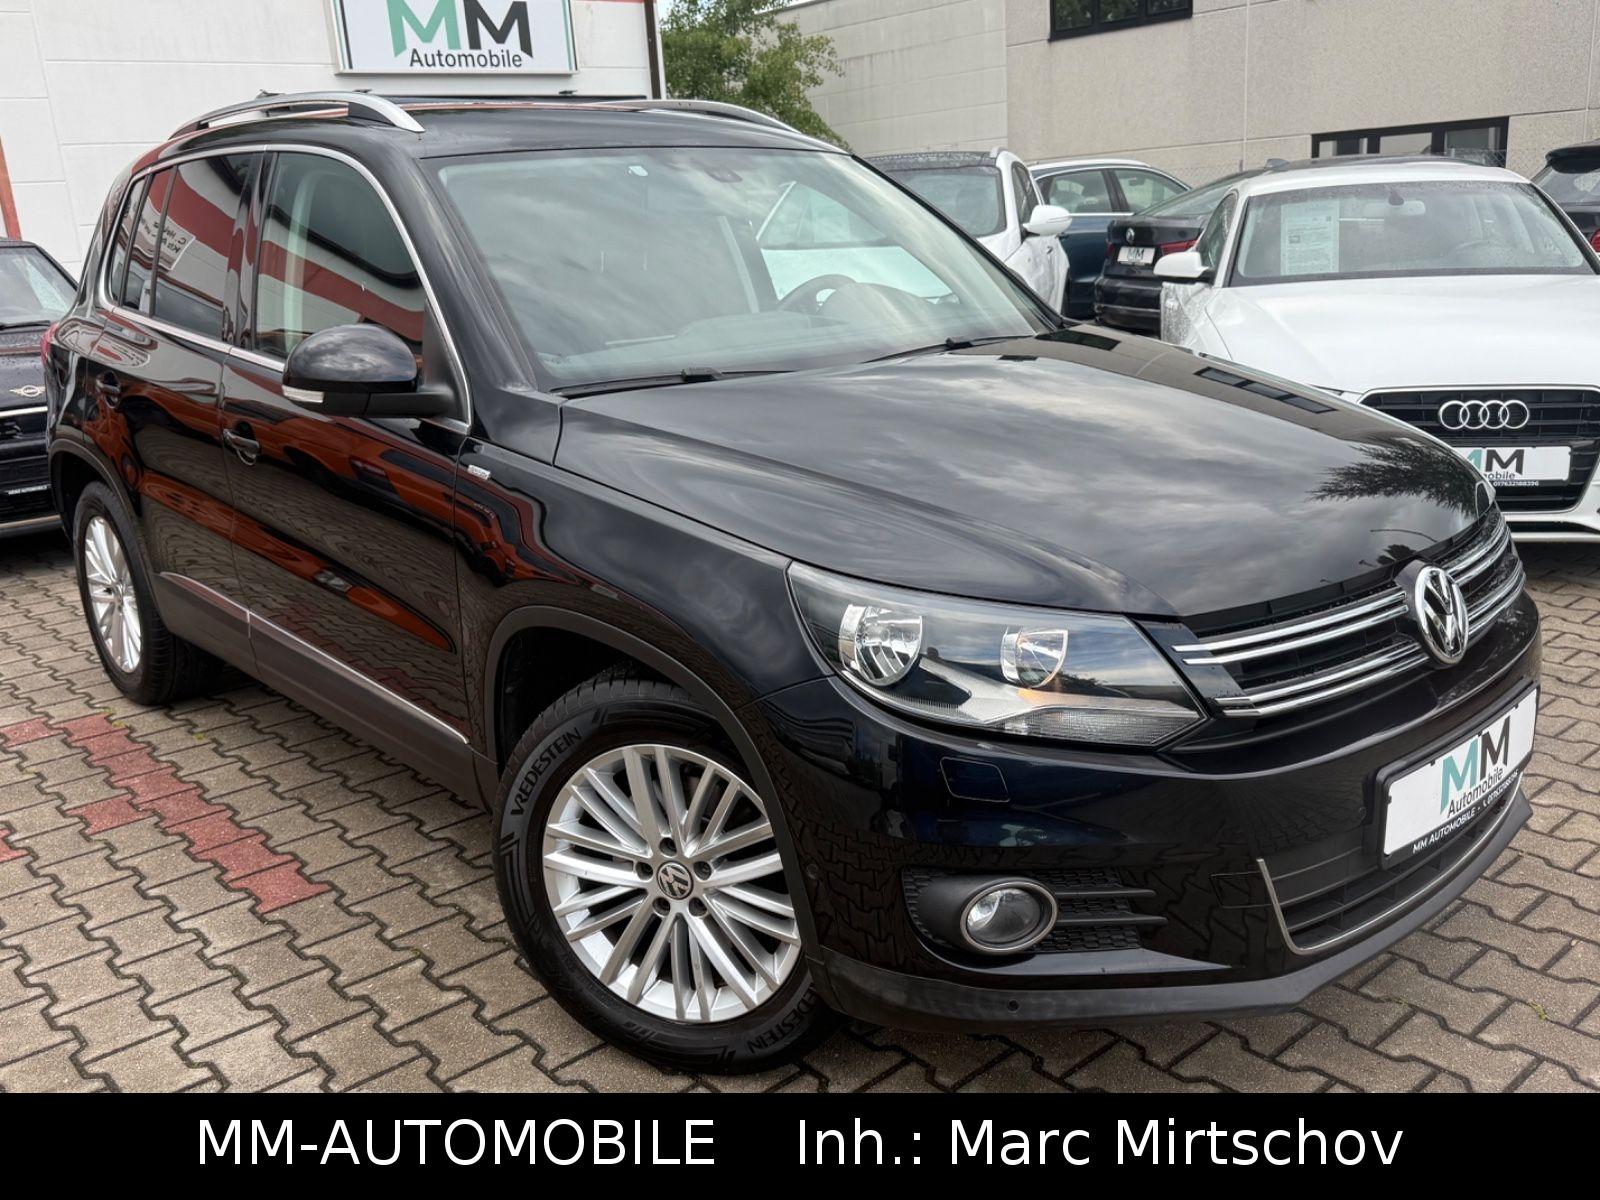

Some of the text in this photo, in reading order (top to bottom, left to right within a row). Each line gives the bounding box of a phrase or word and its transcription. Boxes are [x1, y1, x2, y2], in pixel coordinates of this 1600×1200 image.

[387, 0, 533, 58] MM
[409, 48, 523, 68] Automobile
[510, 727, 582, 816] VREDESTEIN
[1440, 715, 1511, 815] MM
[1447, 767, 1504, 819] Automobile
[1412, 837, 1428, 854] MM
[1429, 807, 1476, 845] AUTOMOBILE
[746, 982, 821, 1054] EDESTEIN
